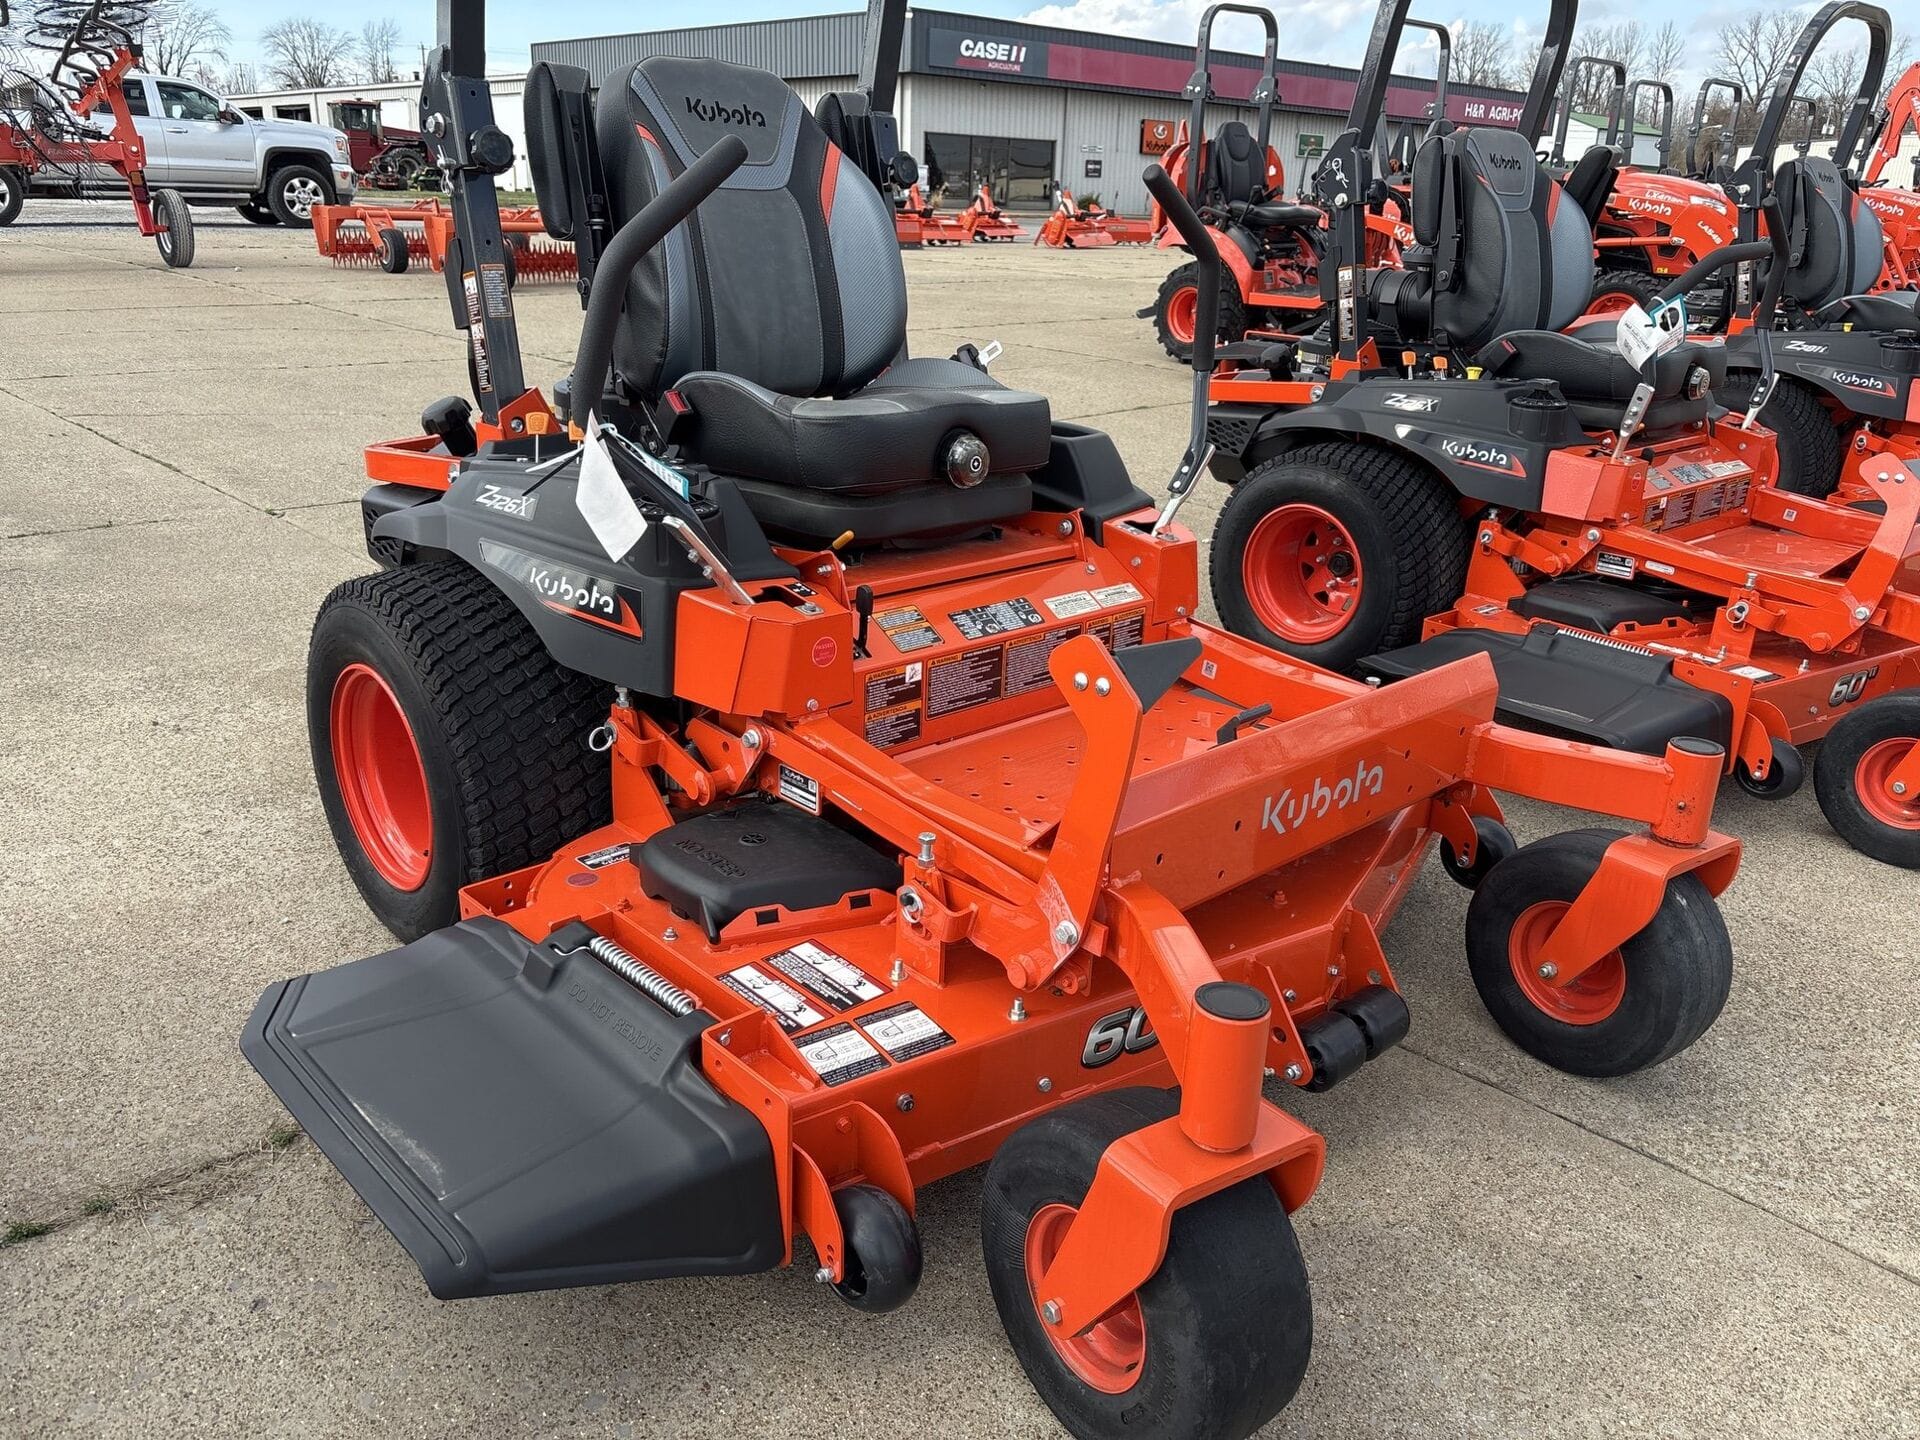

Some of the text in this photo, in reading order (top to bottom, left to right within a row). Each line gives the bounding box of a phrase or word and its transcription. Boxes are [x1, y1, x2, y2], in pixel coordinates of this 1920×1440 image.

[960, 39, 1010, 61] CASE
[685, 96, 766, 128] Kubota
[1464, 102, 1485, 118] H&R
[1489, 153, 1521, 170] Kubota
[1628, 197, 1672, 216] Kubota
[1863, 196, 1905, 217] Kubota
[1832, 371, 1883, 389] Kubota
[1442, 439, 1508, 465] Kubota
[475, 484, 537, 517] Z726X
[529, 567, 615, 615] Kubota
[873, 705, 907, 719] ADVERTENCIA
[1261, 759, 1384, 835] Kubota
[567, 983, 664, 1062] DO NOT REMOVE
